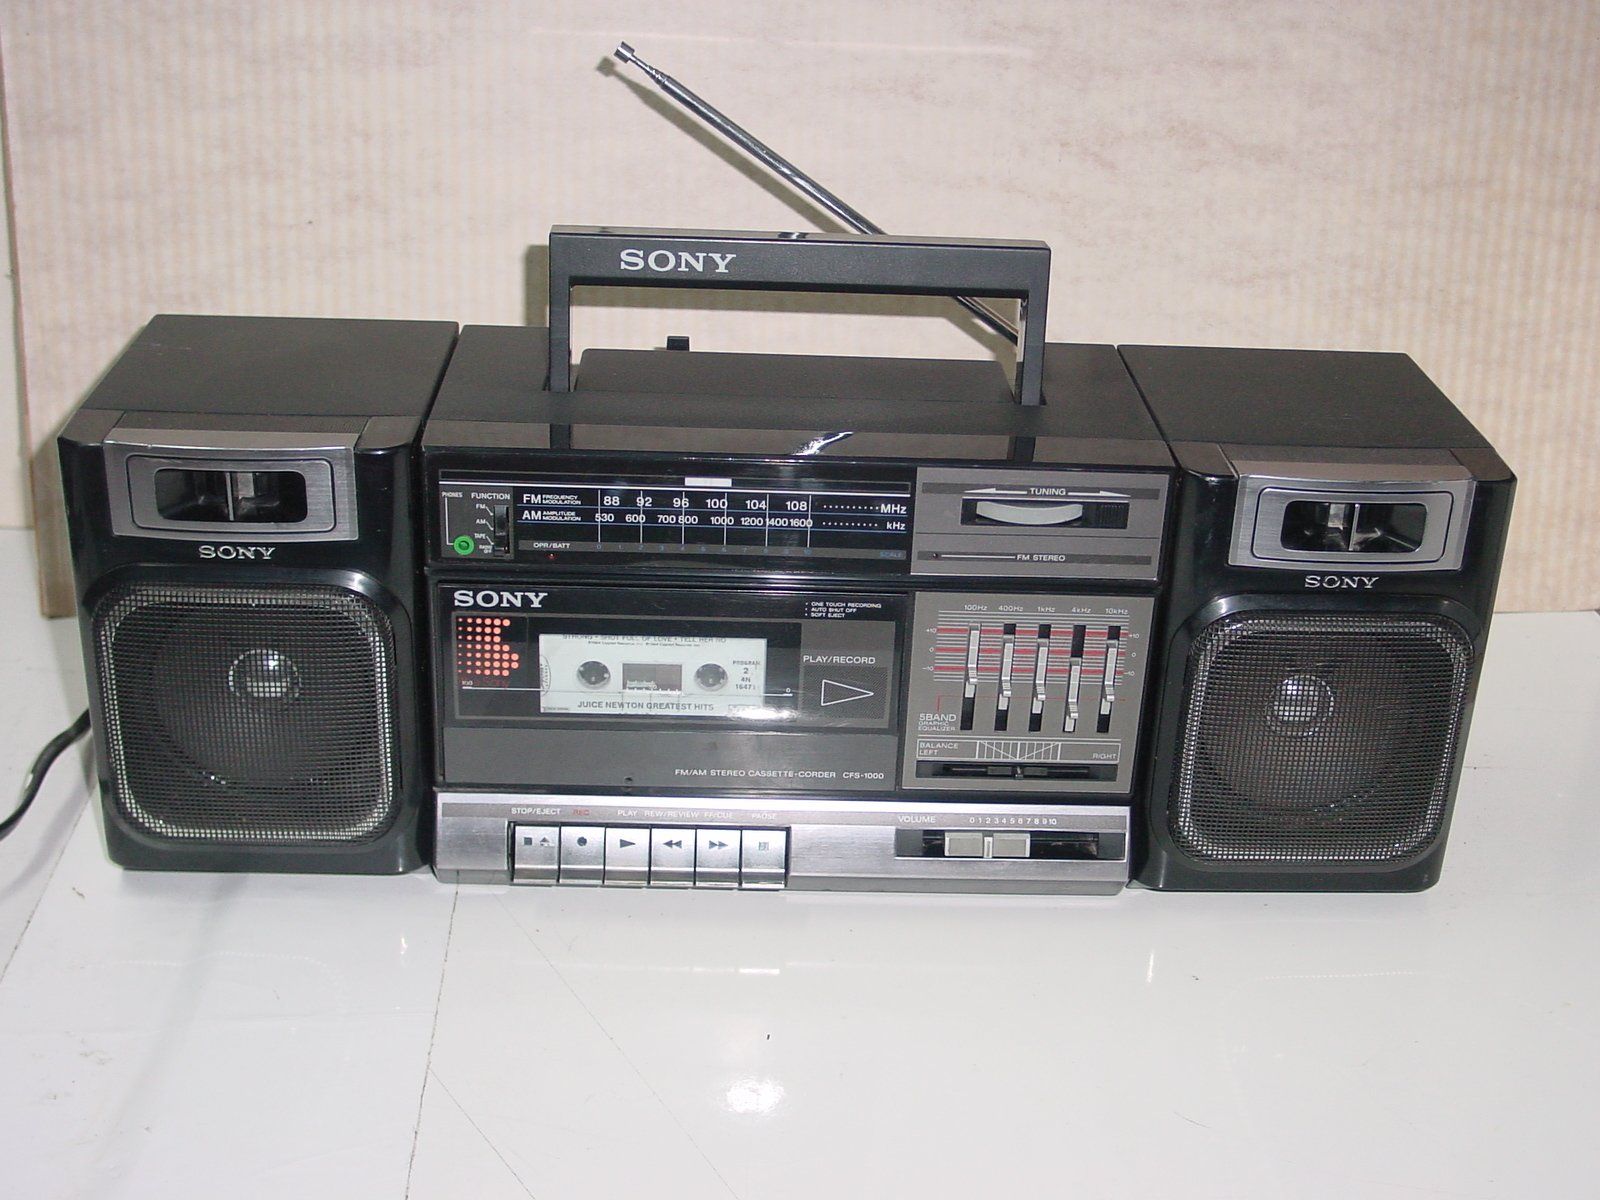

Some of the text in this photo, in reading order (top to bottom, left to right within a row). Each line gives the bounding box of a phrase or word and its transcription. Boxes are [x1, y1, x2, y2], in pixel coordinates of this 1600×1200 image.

[620, 248, 737, 273] SONY
[471, 492, 511, 500] FUNCTION
[1029, 487, 1066, 496] TUNING
[523, 493, 541, 504] FM
[603, 496, 907, 515] 88 92 96 100 104 108 MHz
[522, 510, 542, 520] AM
[594, 513, 906, 531] 530 600 700 800 1000 1200 1400 1600 kHz
[198, 545, 276, 559] SONY
[1033, 554, 1066, 562] STEREO
[1304, 575, 1379, 589] SONY
[453, 590, 548, 608] SONY
[803, 655, 876, 664] PLAY/RECORD
[605, 701, 644, 709] NEWTON
[694, 703, 714, 711] HITS
[710, 769, 745, 777] STEREO
[748, 770, 836, 778] CASSETTE-CORDER
[842, 772, 885, 780] CFS-1000
[644, 810, 699, 818] REW/REVIEW
[898, 815, 936, 823] VOLUME
